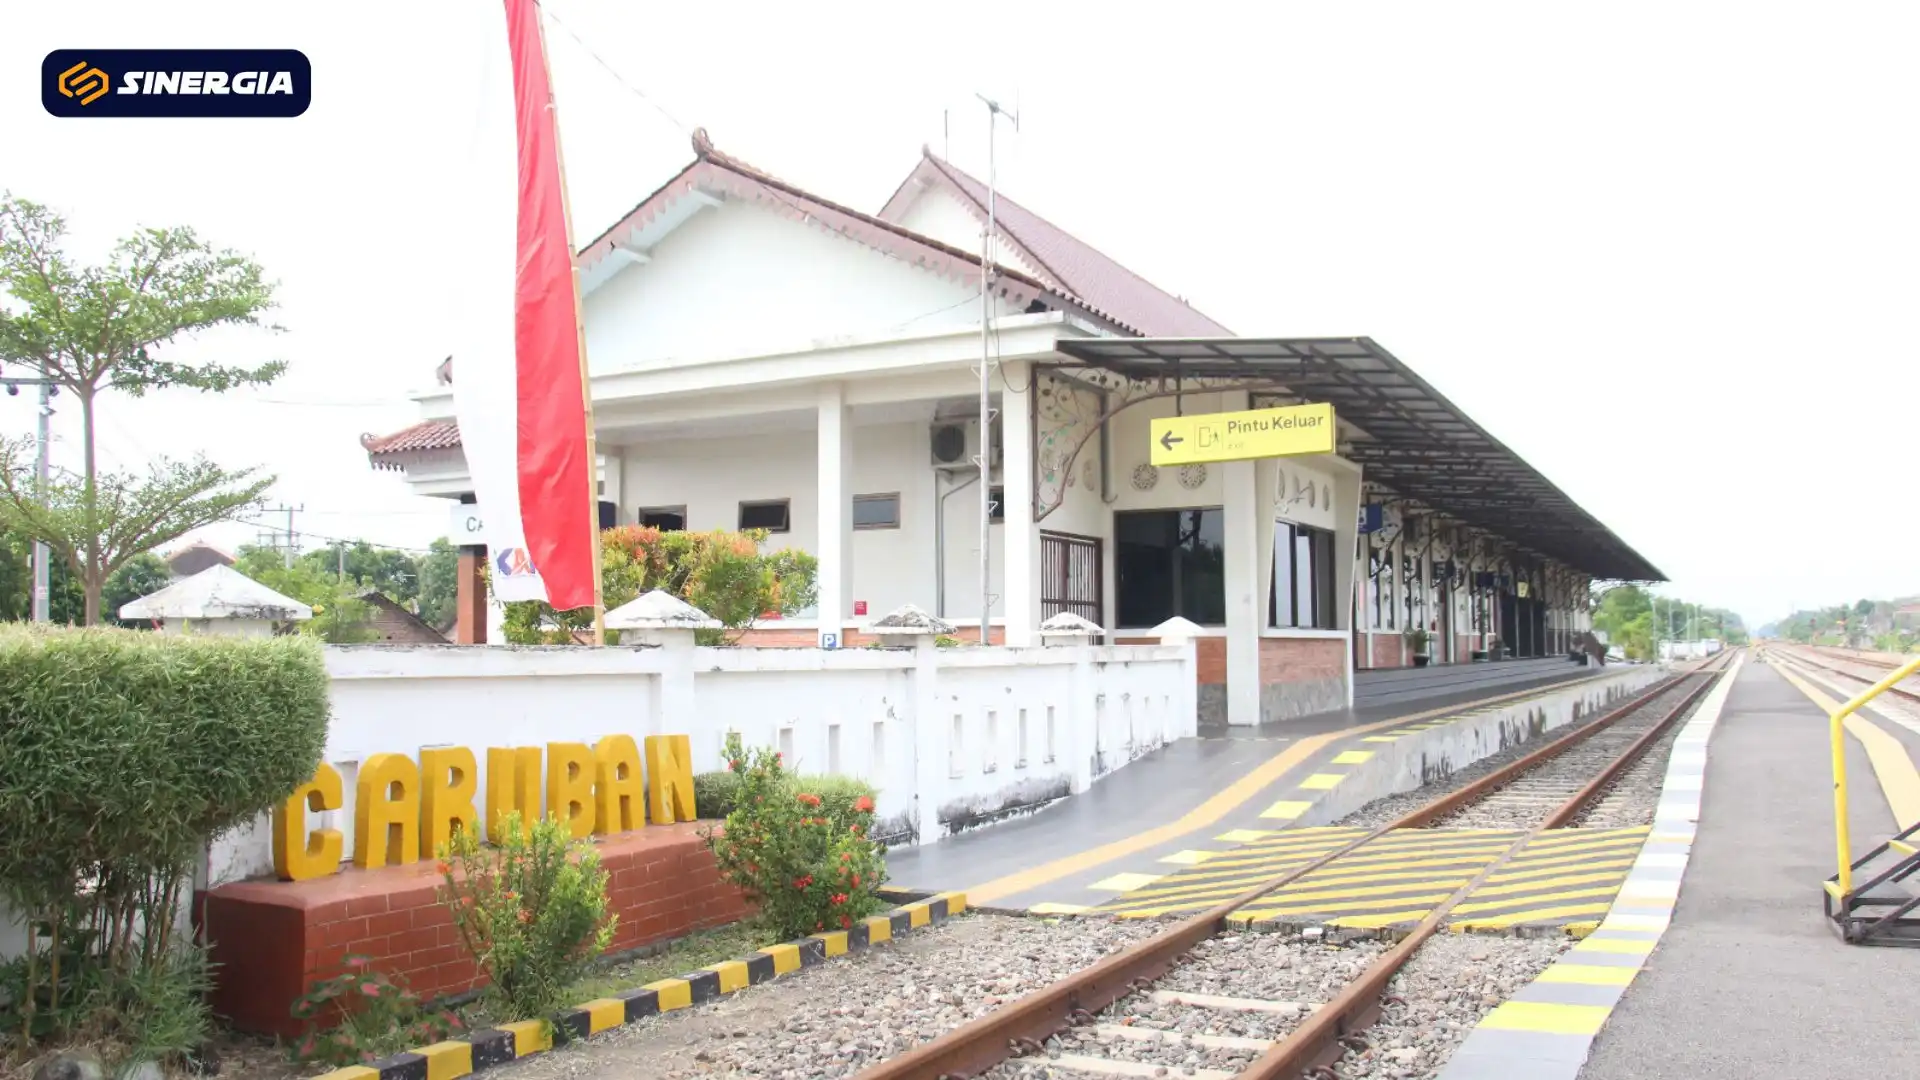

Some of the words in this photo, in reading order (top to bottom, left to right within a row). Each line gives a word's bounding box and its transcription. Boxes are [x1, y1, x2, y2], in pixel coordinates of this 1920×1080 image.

[1228, 419, 1268, 434] Pintu
[1272, 414, 1324, 430] Keluar
[272, 733, 698, 882] CARUBAN
